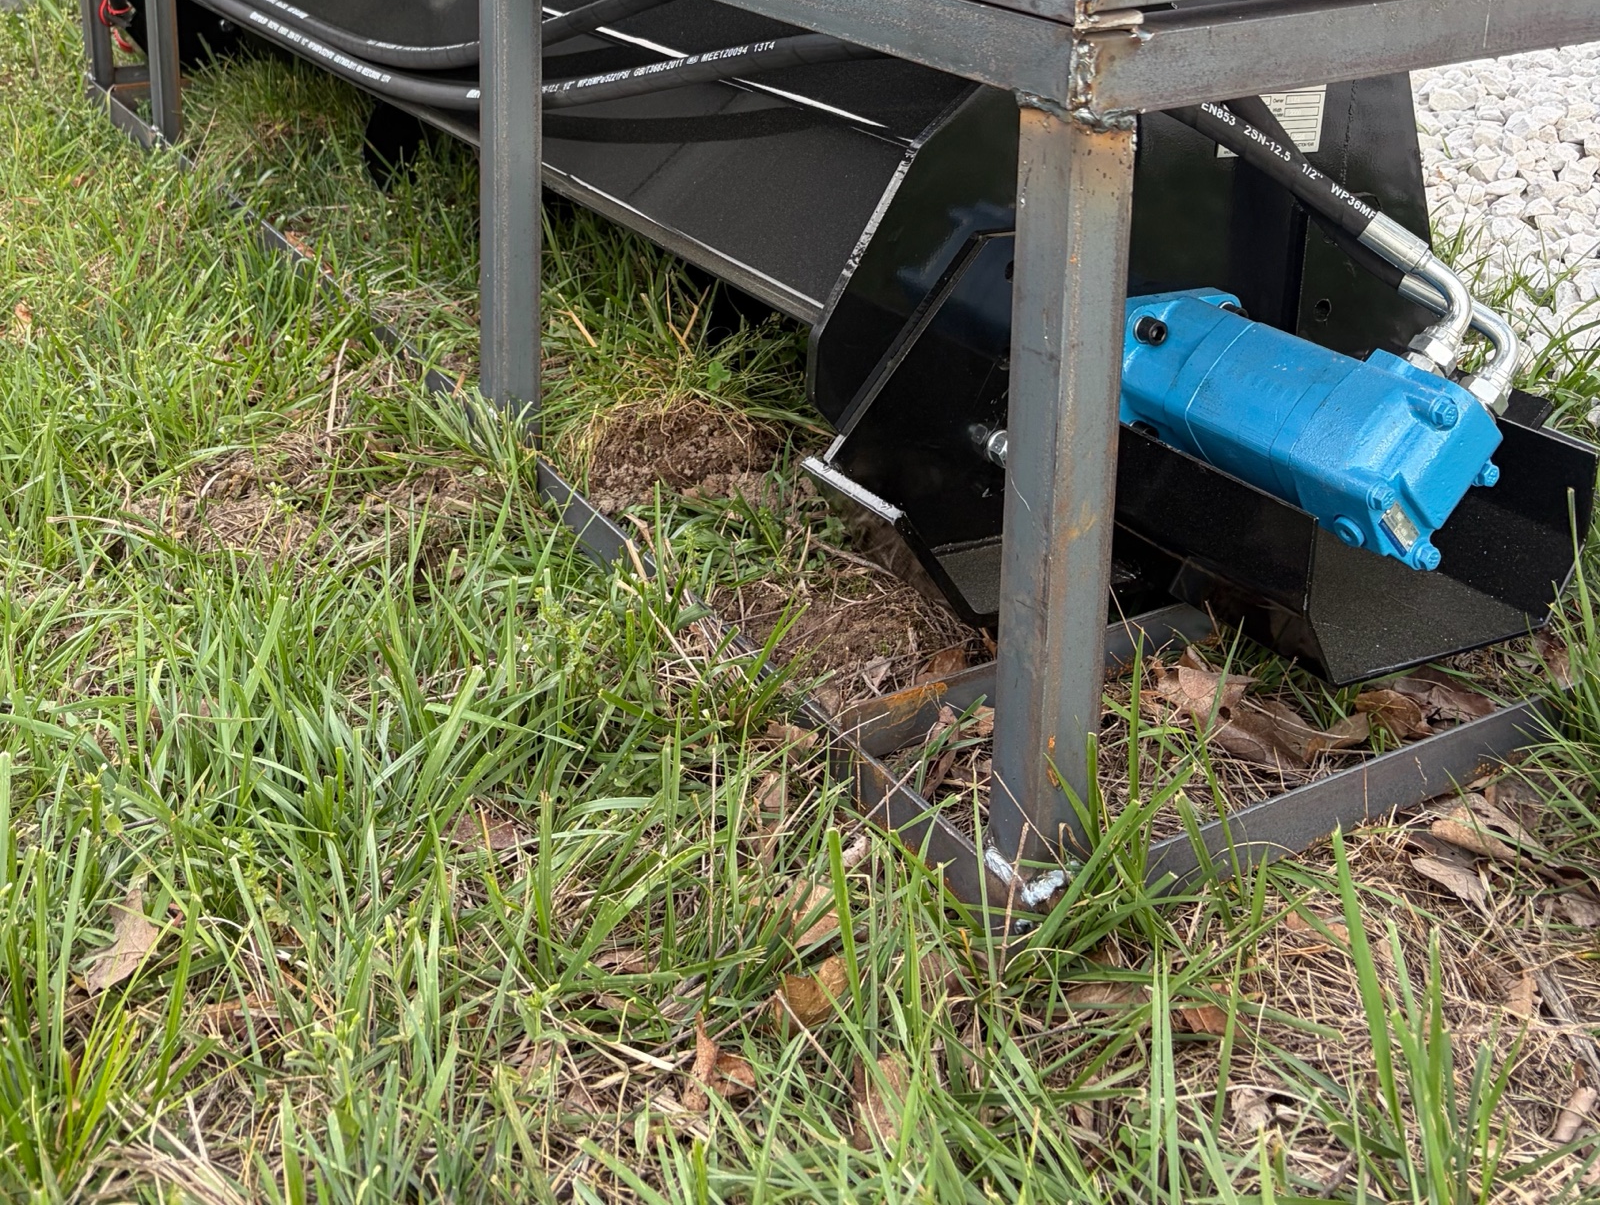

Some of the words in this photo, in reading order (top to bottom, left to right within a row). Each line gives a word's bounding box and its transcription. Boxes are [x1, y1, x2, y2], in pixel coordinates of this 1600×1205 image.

[701, 46, 748, 63] MEE120094
[753, 41, 775, 52] 13T4
[1201, 101, 1236, 126] EN853
[1243, 124, 1291, 162] 2SN-12.5
